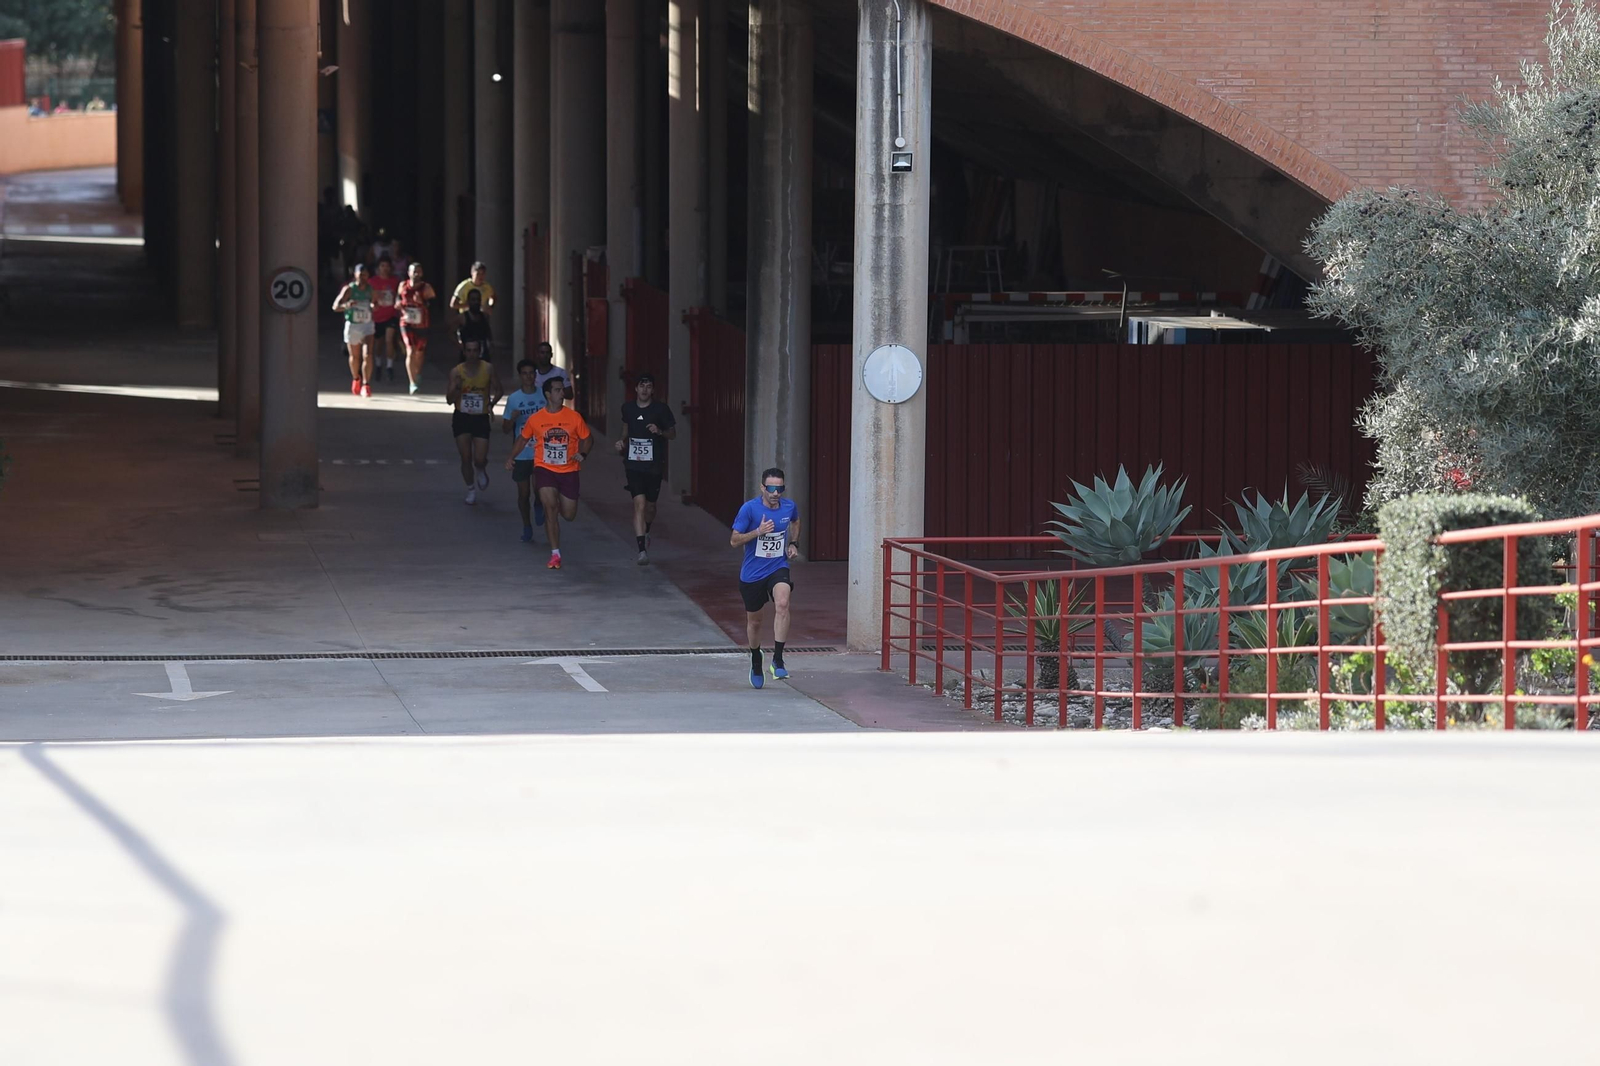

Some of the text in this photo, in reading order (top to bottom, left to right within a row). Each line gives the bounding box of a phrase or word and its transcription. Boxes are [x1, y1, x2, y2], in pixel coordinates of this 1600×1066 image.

[273, 279, 304, 299] 20
[464, 400, 480, 408] 534
[547, 450, 564, 459] 218
[633, 446, 649, 455] 255
[761, 541, 781, 551] 520
